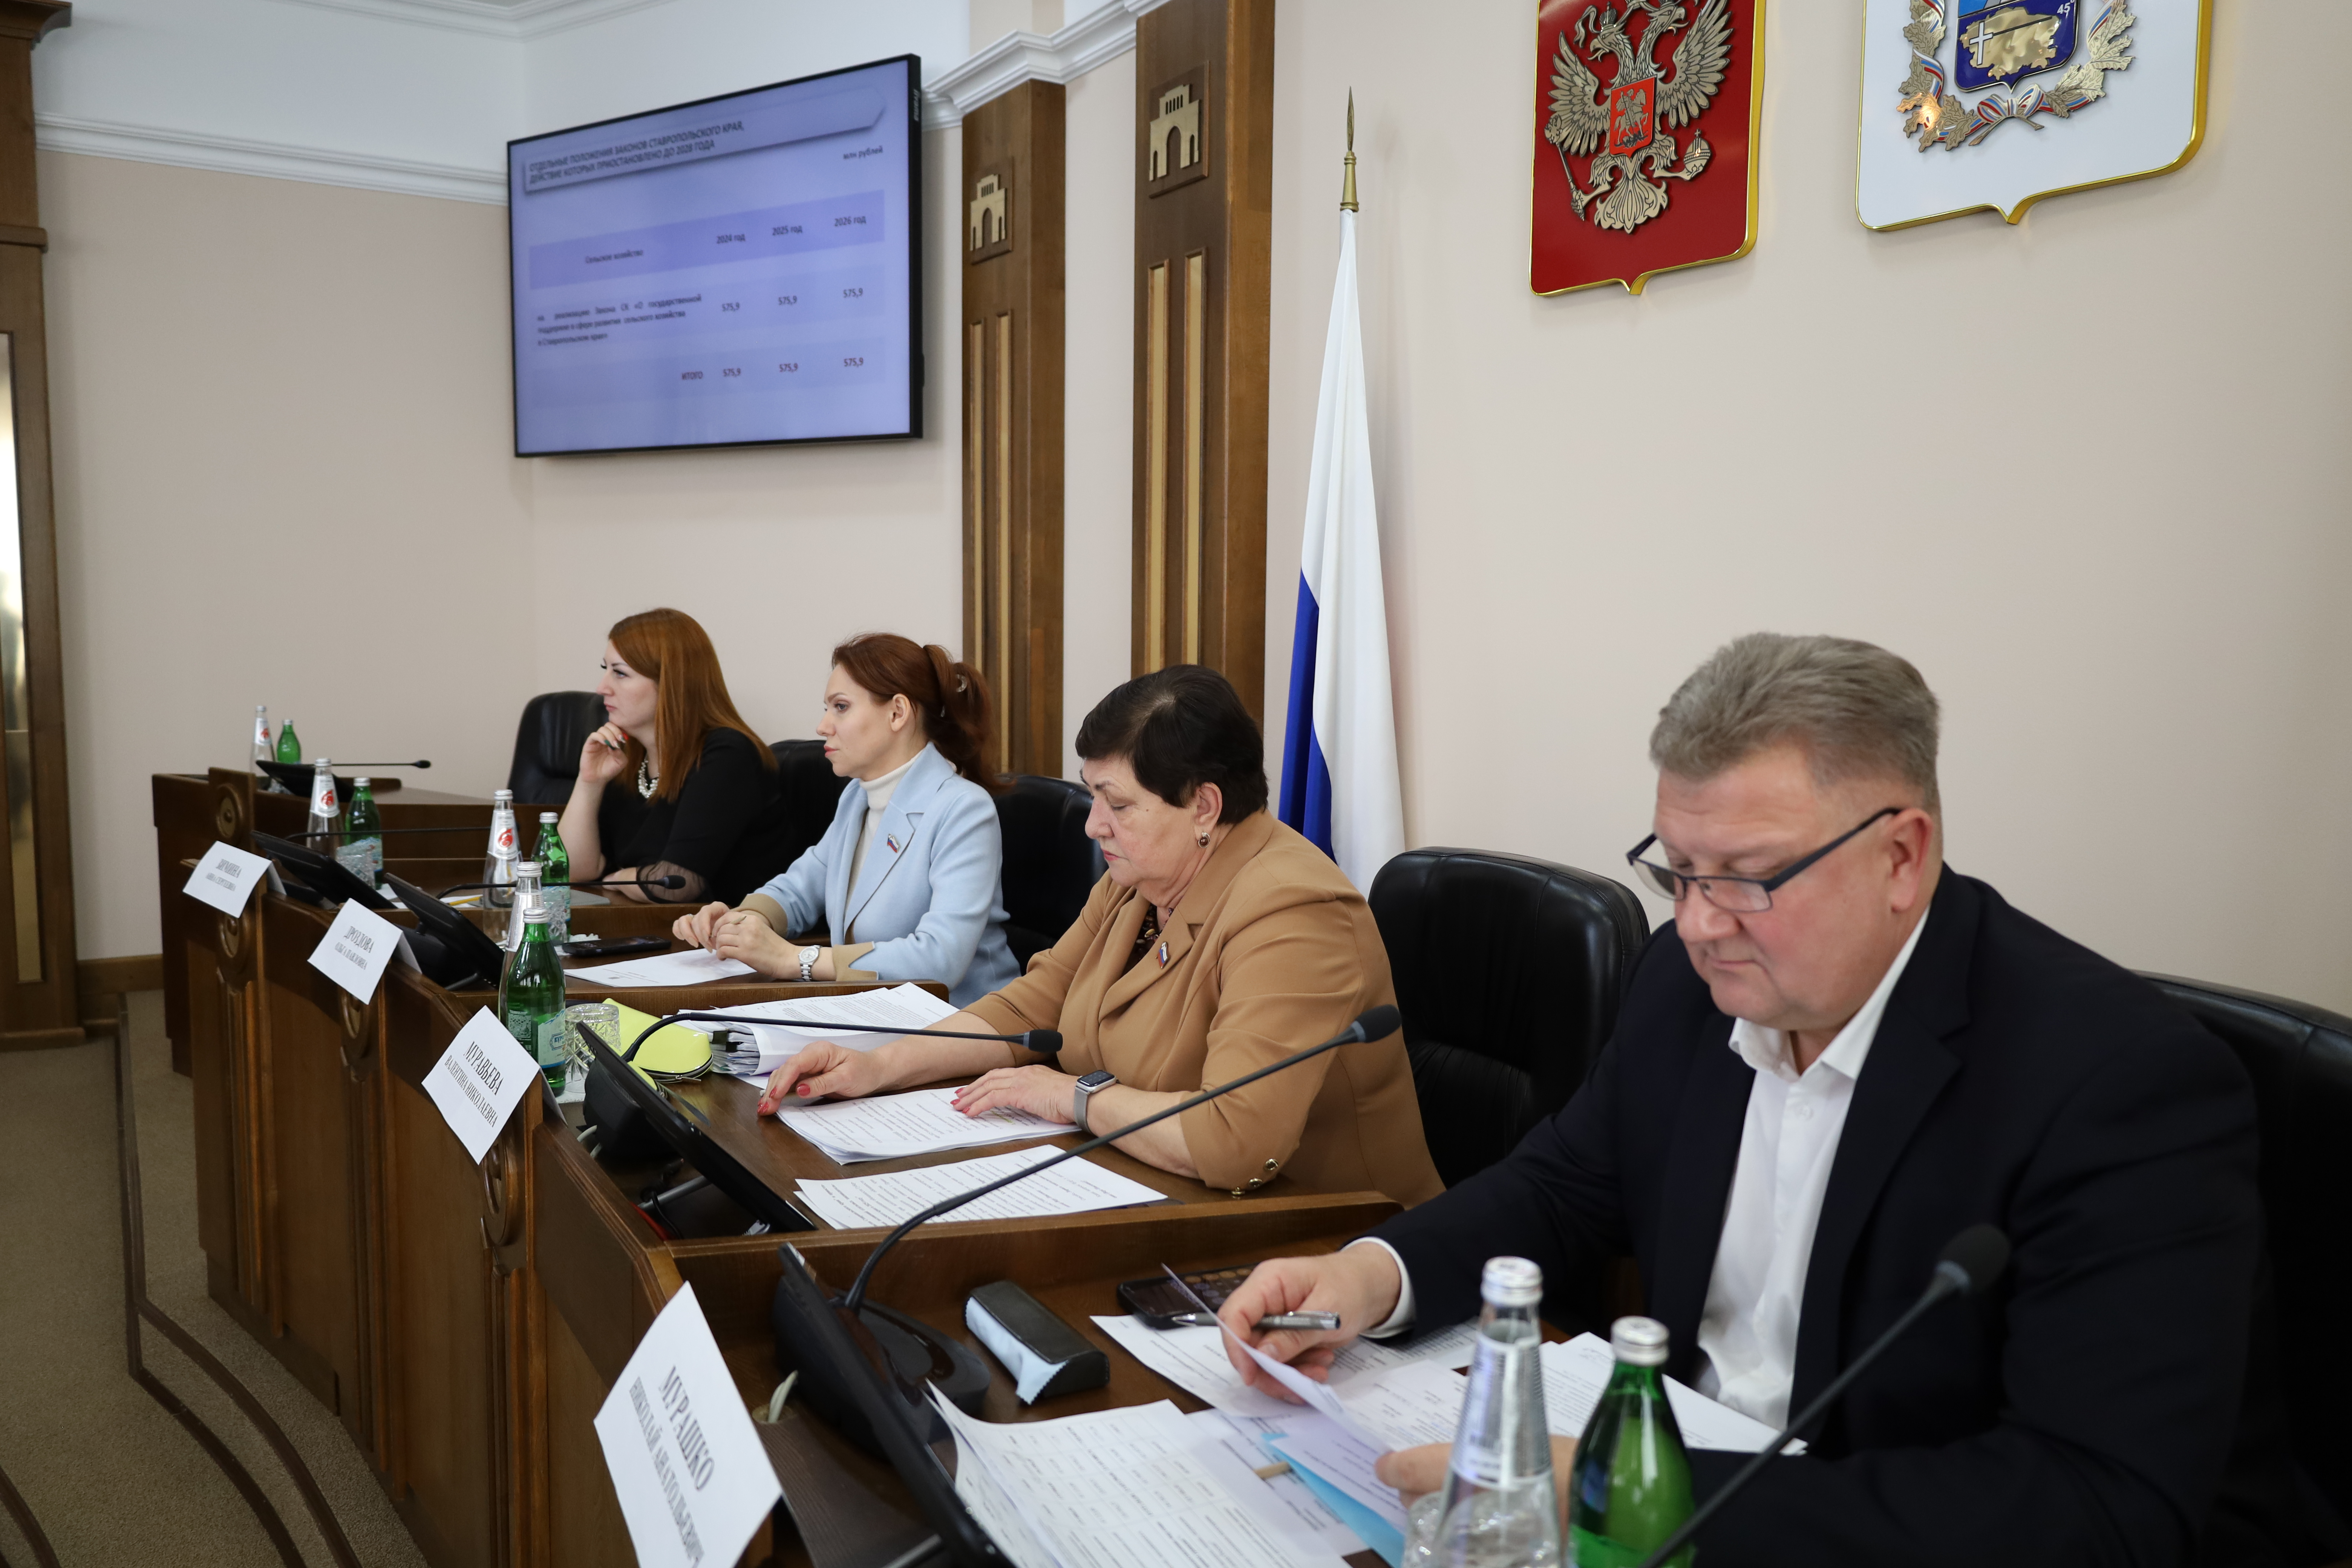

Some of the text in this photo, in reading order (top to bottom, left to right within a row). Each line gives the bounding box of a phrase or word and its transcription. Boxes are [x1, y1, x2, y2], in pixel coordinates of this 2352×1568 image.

[649, 125, 721, 148] СТАВРОПОЛЬСКОГО
[723, 121, 744, 132] КРАЯ,
[663, 147, 675, 158] ДО
[695, 139, 715, 151] ГОДА
[858, 145, 883, 159] рублей
[834, 216, 867, 227] 2026 год
[772, 225, 802, 236] 2025 год
[717, 233, 746, 244] 2024 год
[843, 288, 864, 298] 575,9
[778, 295, 798, 306] 575,9
[722, 302, 740, 312] 575,9
[779, 363, 798, 373] 575,9
[844, 357, 864, 368] 575,9
[681, 371, 703, 380] ИТОГО
[723, 368, 741, 377] 575,9
[343, 926, 374, 954] ДРОЗДОВА
[463, 1041, 504, 1096] МУРАВЬЕВА
[444, 1055, 499, 1128] ВАЛЕНТИНА НИКОЛАЕВНА
[629, 1376, 663, 1454] НИКОЛАЙ
[658, 1365, 715, 1491] МУРАШКО
